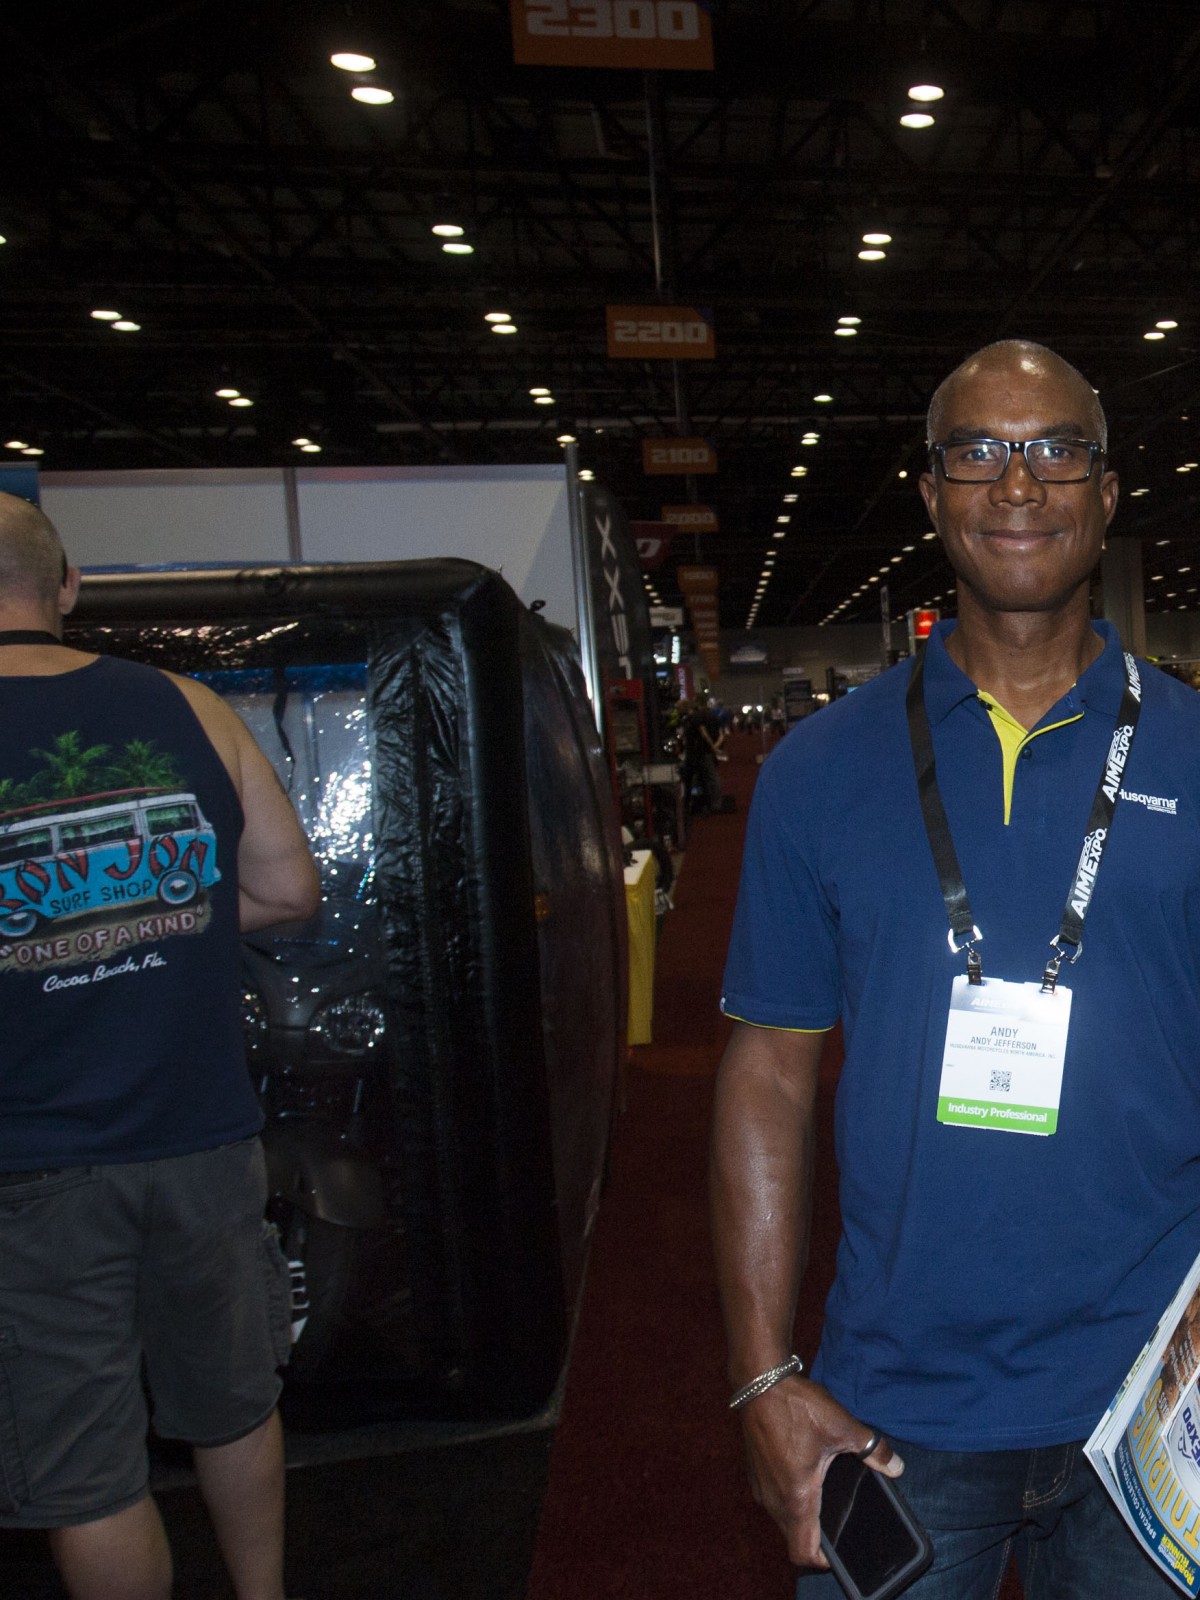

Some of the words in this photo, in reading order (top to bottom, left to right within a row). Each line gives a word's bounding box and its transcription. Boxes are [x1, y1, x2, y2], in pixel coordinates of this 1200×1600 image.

[525, 0, 700, 40] 2300
[614, 320, 707, 343] 2200
[652, 448, 709, 464] 2100
[1102, 725, 1134, 804] AIMEXPO
[104, 834, 209, 881] JON
[1070, 827, 1107, 920] AIMEXPO
[50, 891, 92, 915] SURF
[102, 879, 154, 902] SHOP
[77, 930, 110, 952] OF
[116, 926, 132, 945] A
[43, 972, 91, 993] Cocoa
[93, 956, 140, 983] Beach,
[141, 952, 168, 969] Fla.
[970, 1036, 991, 1046] ANDY
[994, 1039, 1037, 1051] JEFFERSON
[990, 1026, 1019, 1039] ANDY
[948, 1102, 988, 1118] Industry
[990, 1107, 1048, 1122] Professional
[1136, 1507, 1157, 1540] SPECIAL
[1160, 1533, 1191, 1567] RUNNER
[1173, 1561, 1196, 1586] Road
